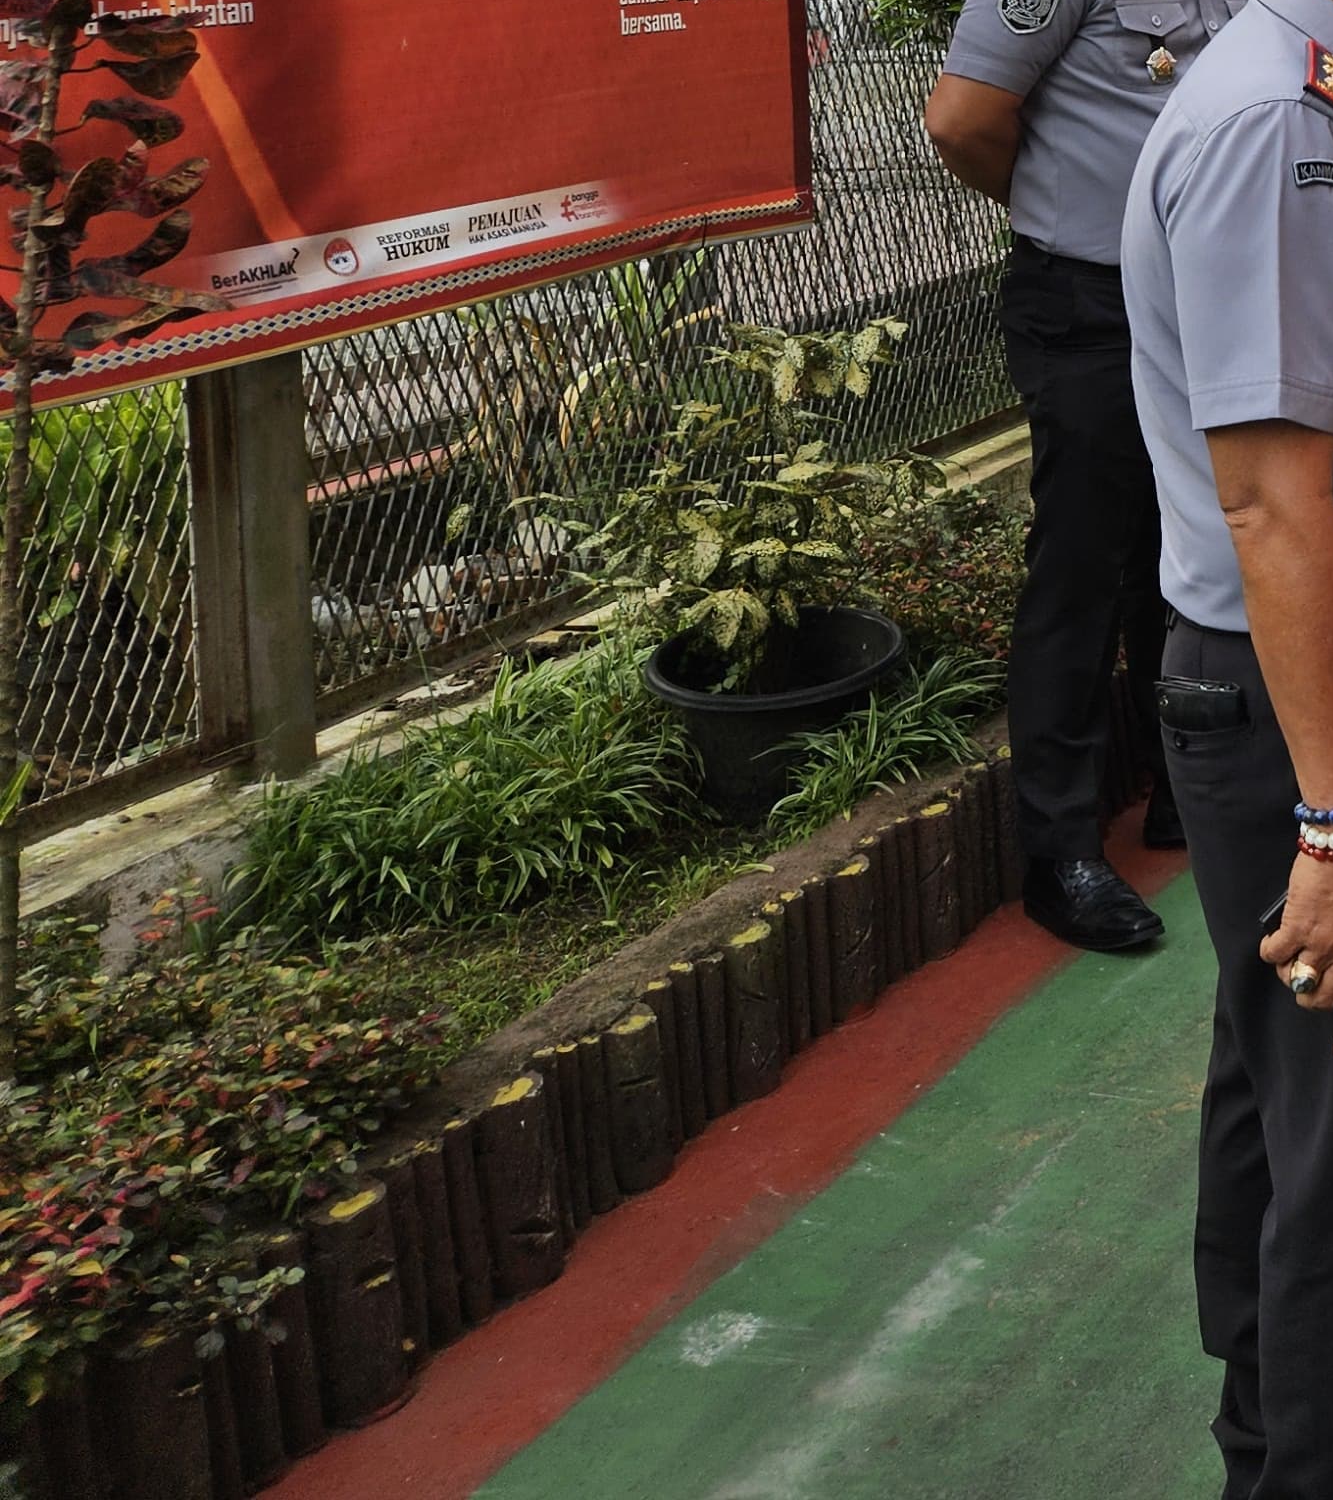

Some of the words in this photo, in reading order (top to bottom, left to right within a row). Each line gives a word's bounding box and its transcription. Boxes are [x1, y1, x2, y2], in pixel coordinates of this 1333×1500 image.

[620, 9, 687, 35] bersama.
[468, 203, 542, 232] PEMAJUAN
[376, 223, 450, 246] REFORMASI
[469, 235, 486, 244] HAK
[487, 230, 510, 242] ASASI
[511, 221, 548, 235] MANUSIA
[383, 235, 450, 261] HUKUM
[211, 260, 296, 289] BerAKHLAK
